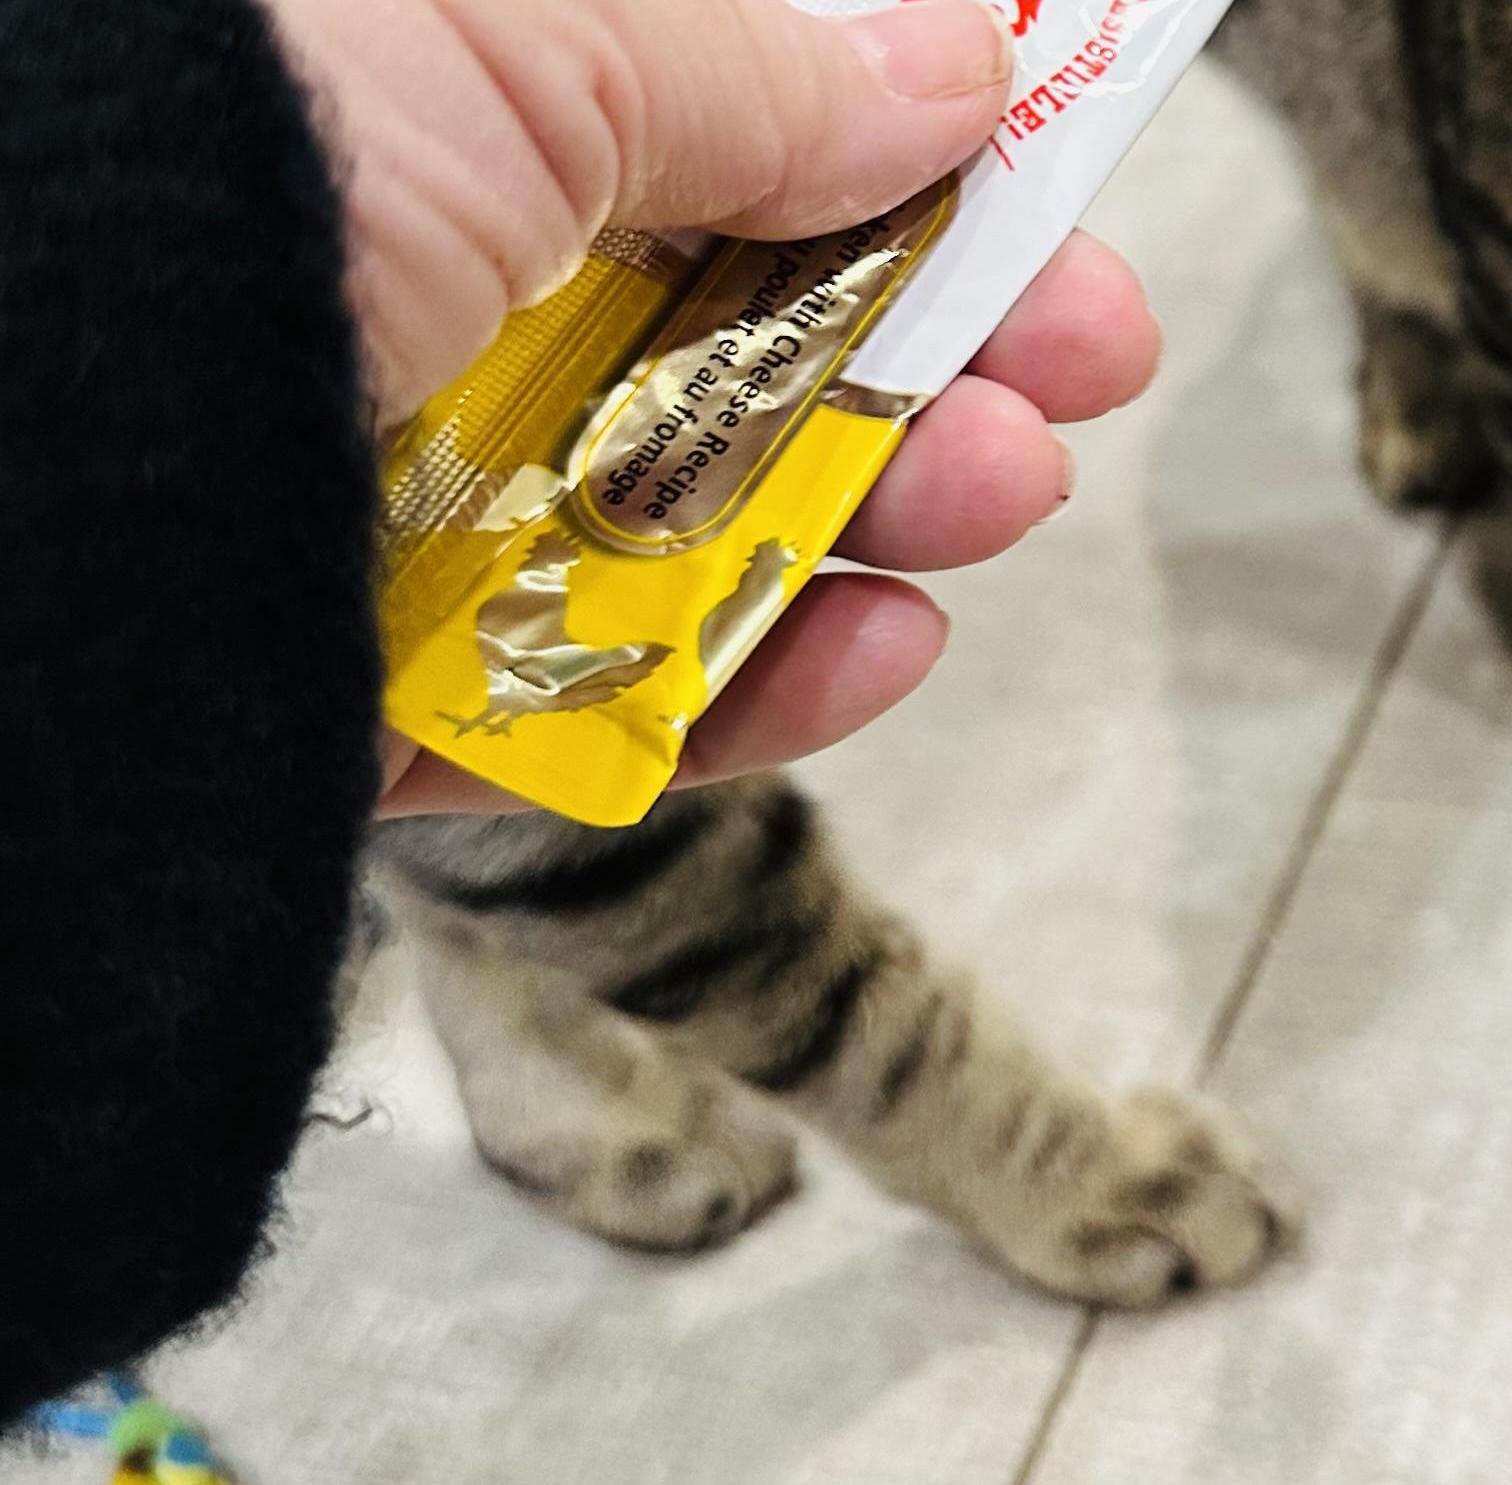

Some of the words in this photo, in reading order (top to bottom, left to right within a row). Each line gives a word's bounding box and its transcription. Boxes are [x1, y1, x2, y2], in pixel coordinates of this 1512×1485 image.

[731, 252, 799, 337] poulet
[788, 268, 843, 329] with
[683, 367, 718, 402] au
[709, 339, 741, 367] et
[717, 335, 800, 428] Cheese
[603, 405, 698, 506] fromage
[644, 432, 730, 519] Recipe
